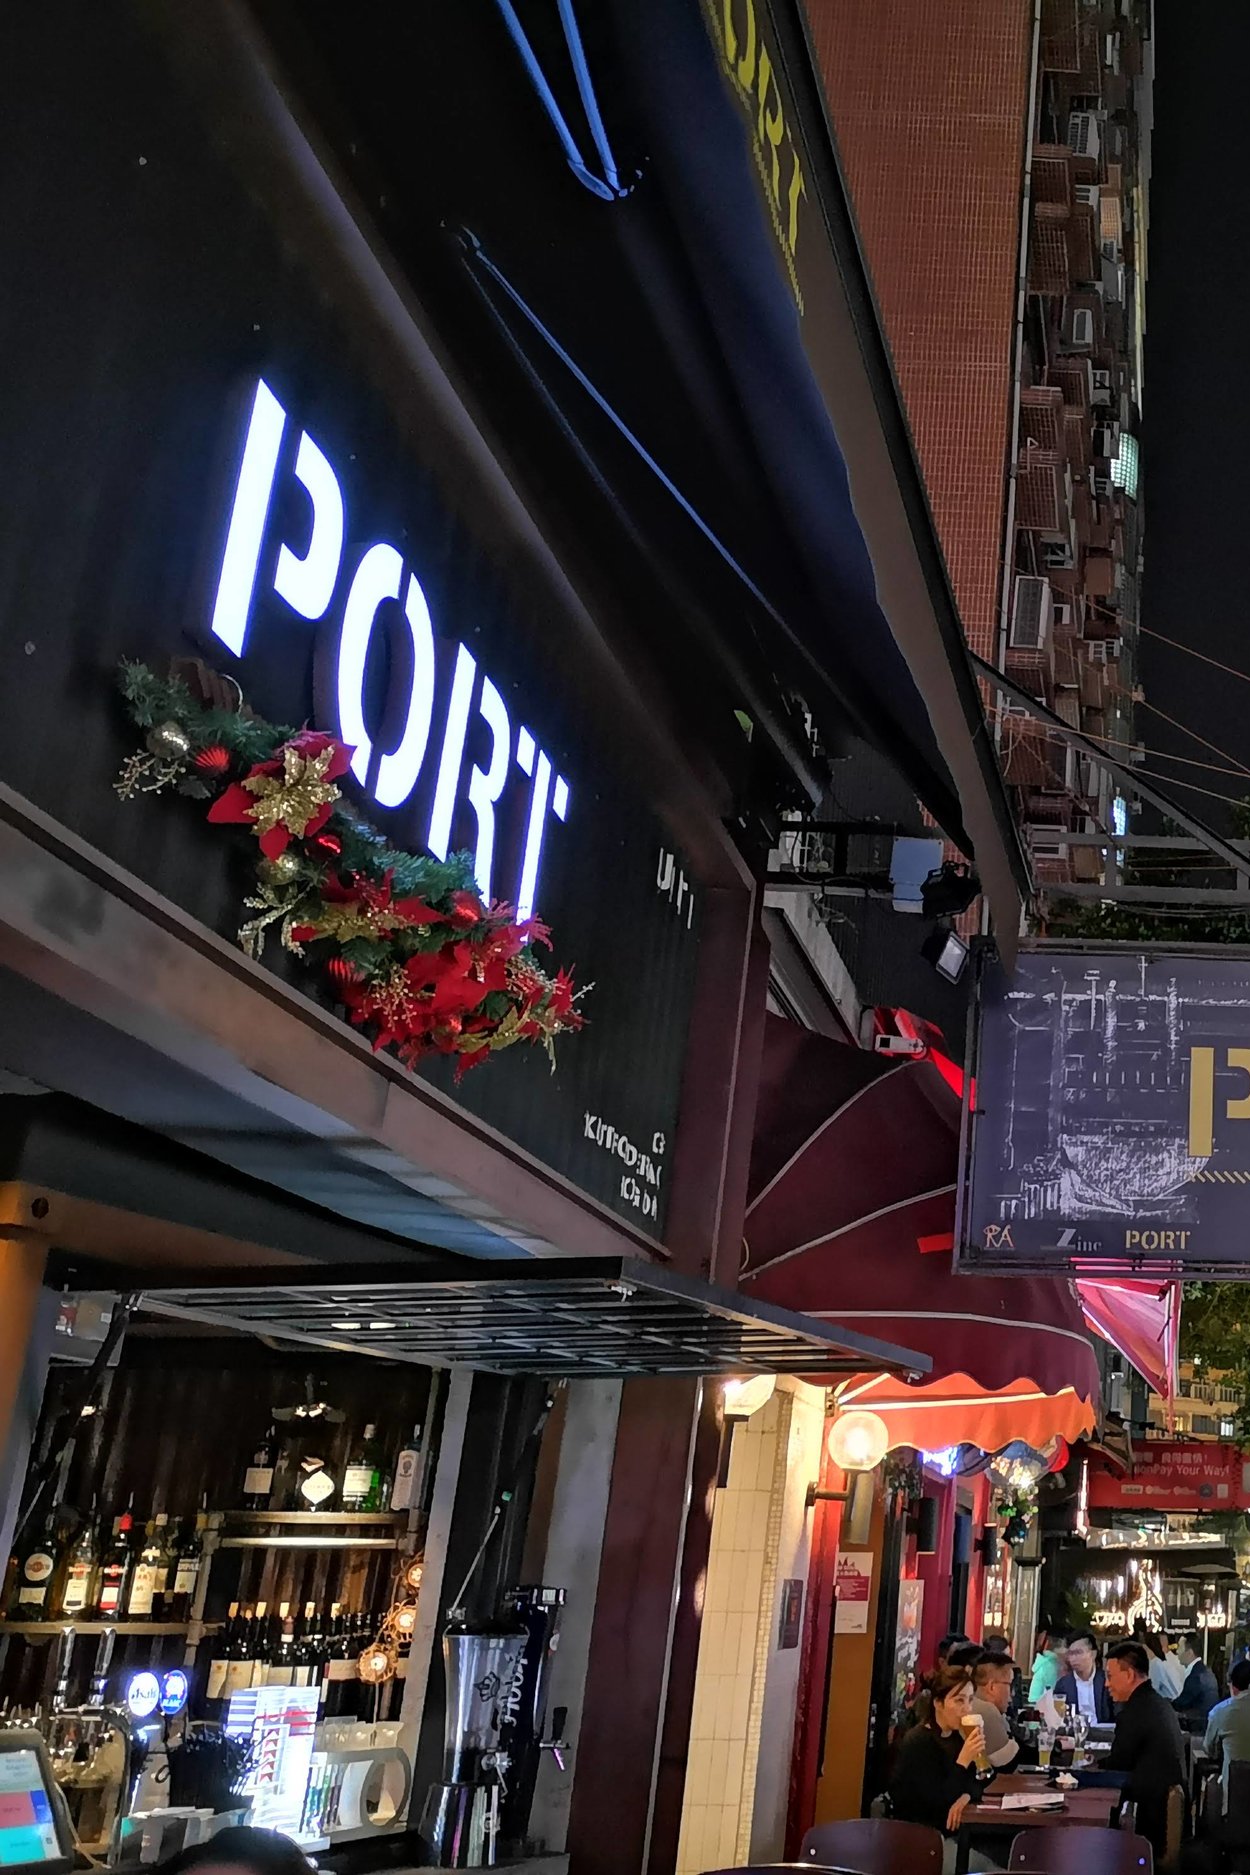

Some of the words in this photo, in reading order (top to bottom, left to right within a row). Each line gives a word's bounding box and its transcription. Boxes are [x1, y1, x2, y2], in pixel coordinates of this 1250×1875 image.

[211, 376, 570, 944] PORT
[1125, 1229, 1191, 1249] PORT
[1176, 1464, 1201, 1476] Your
